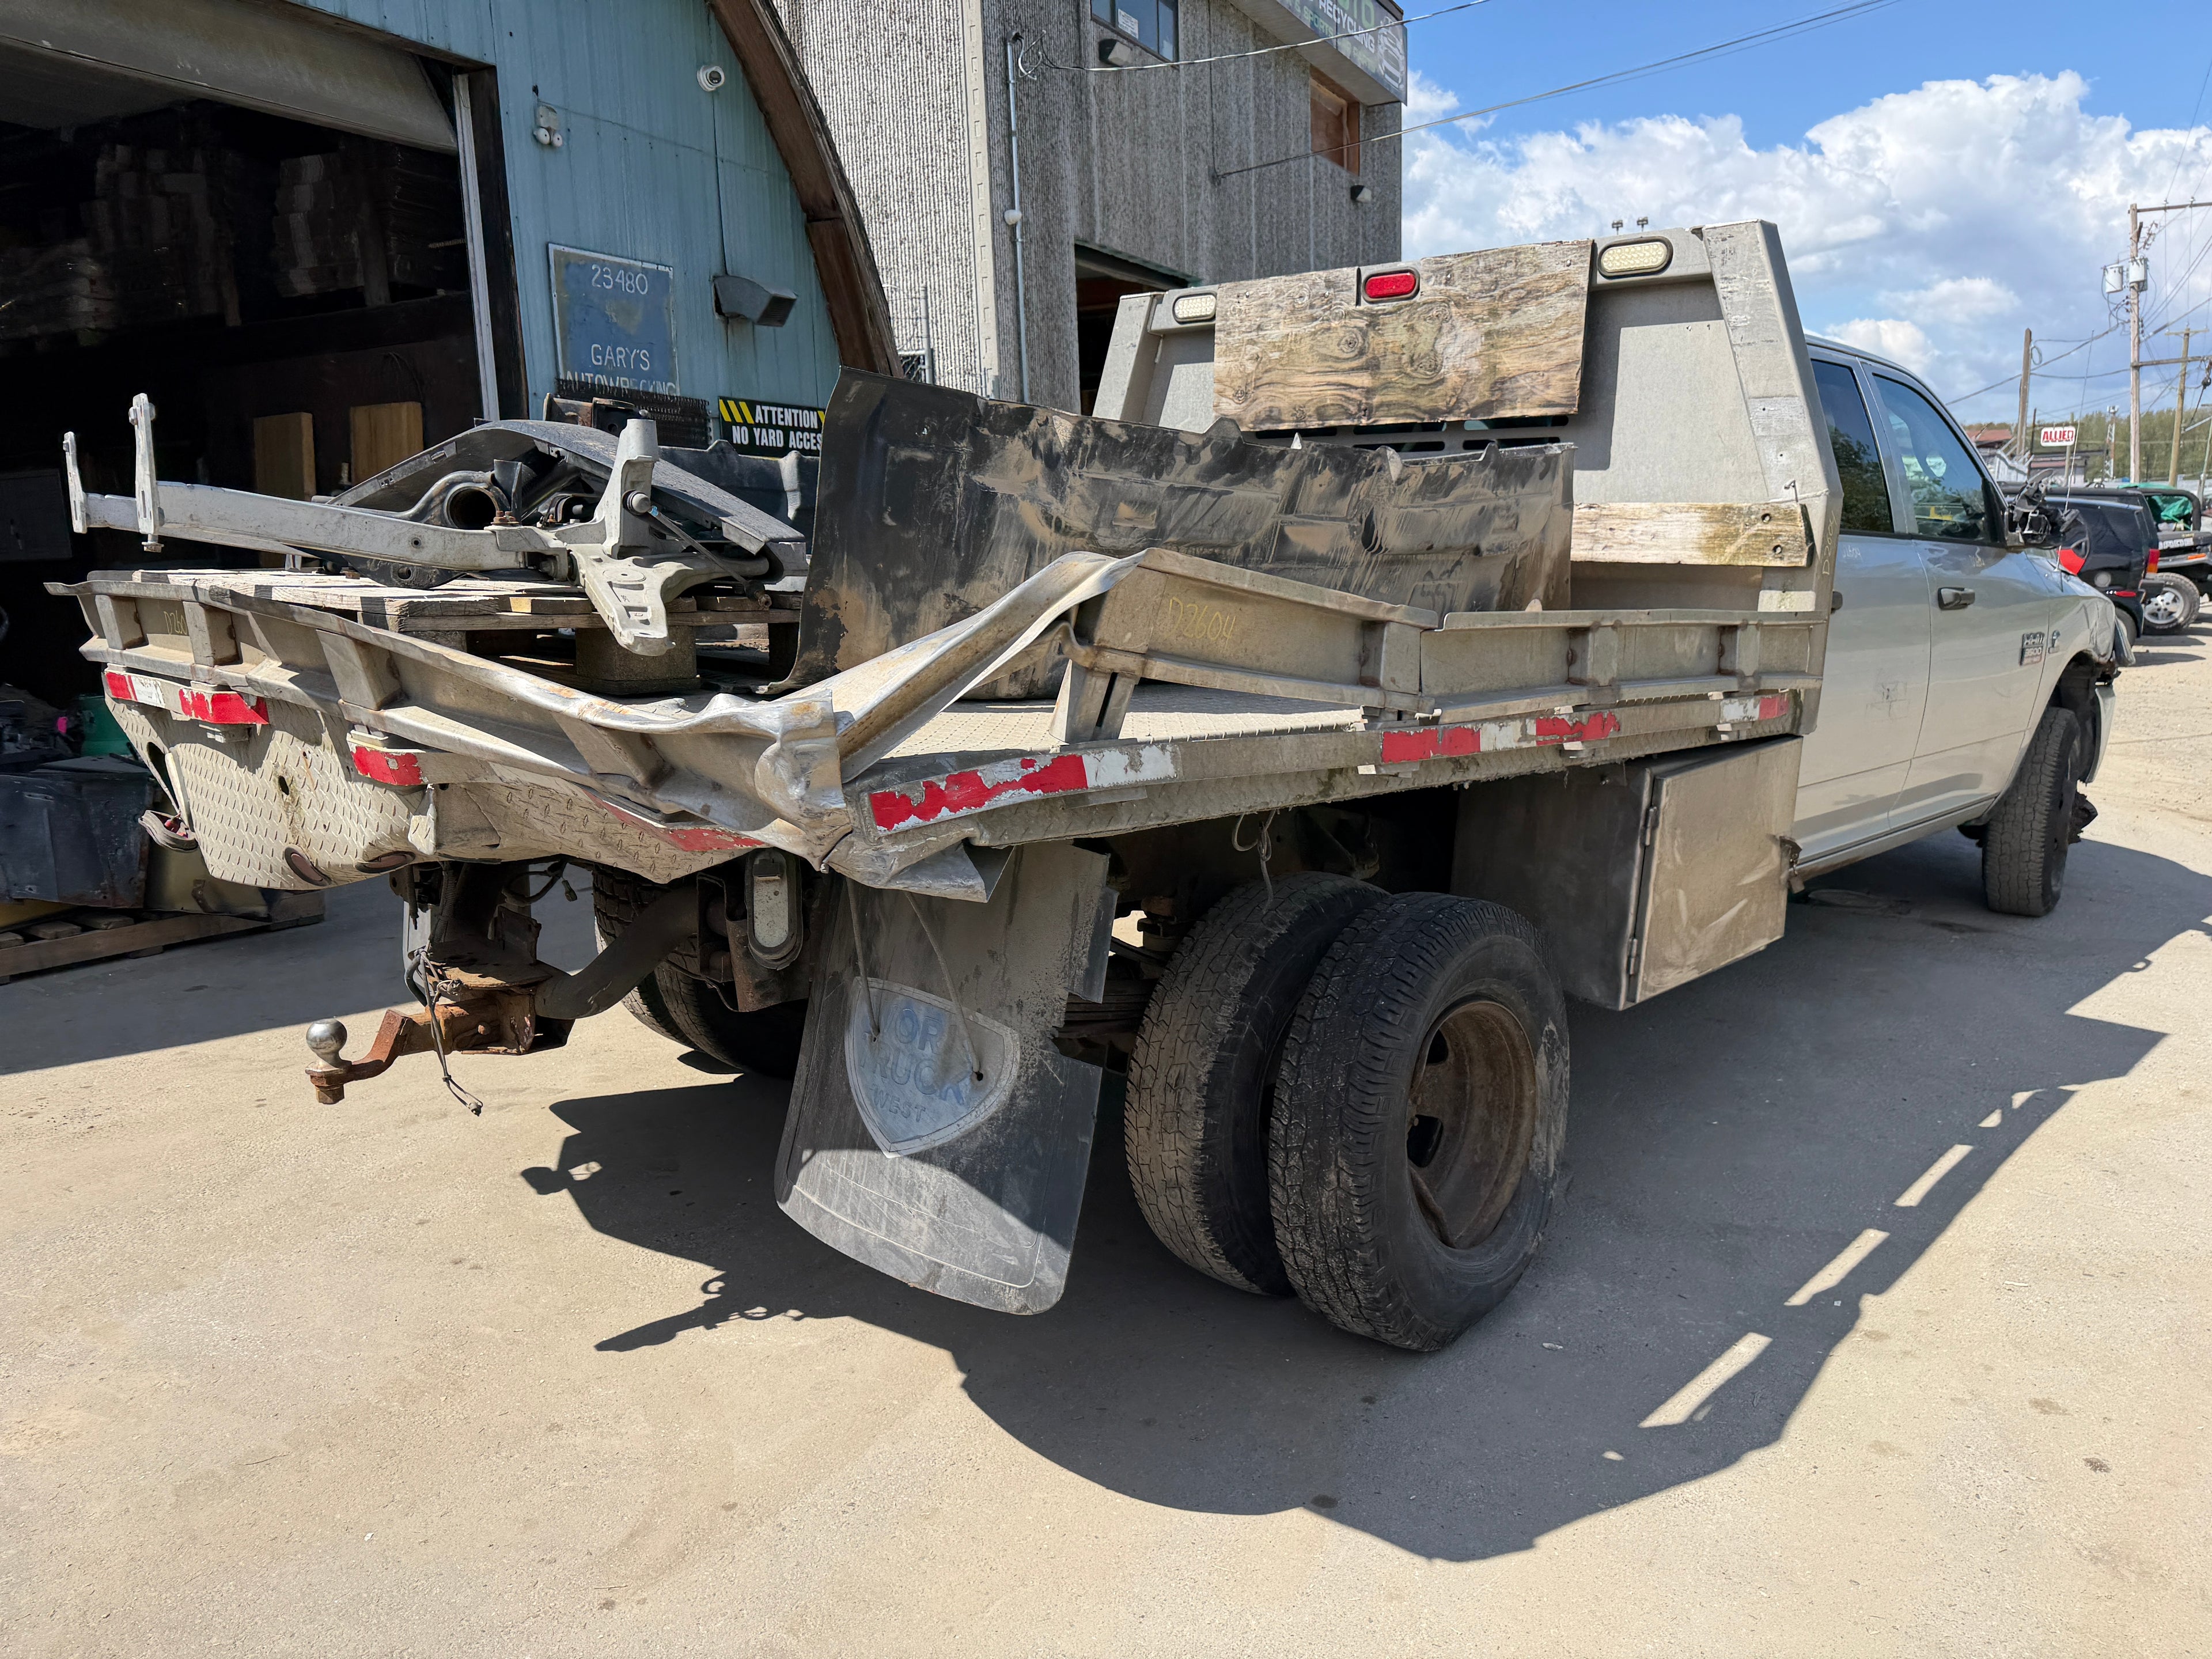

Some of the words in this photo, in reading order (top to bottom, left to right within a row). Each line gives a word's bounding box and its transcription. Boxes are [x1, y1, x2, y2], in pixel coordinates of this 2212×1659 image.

[591, 264, 648, 295] 23480
[591, 344, 650, 371] GARY'S
[755, 404, 818, 429] ATTENTION
[732, 425, 749, 445] NO
[753, 427, 784, 448] YARD
[2042, 430, 2074, 441] ALLIED
[1166, 596, 1236, 650] D2604
